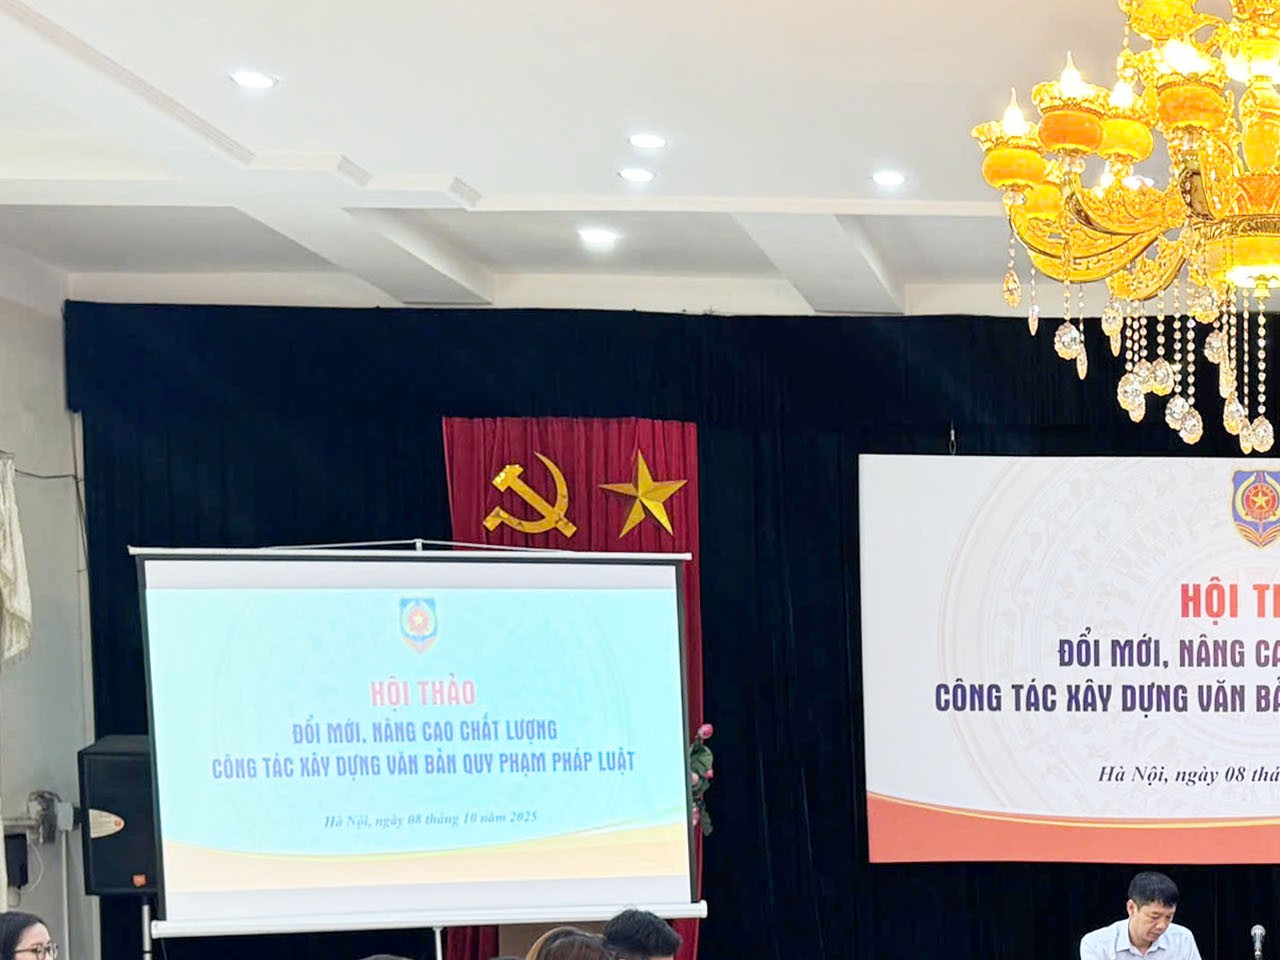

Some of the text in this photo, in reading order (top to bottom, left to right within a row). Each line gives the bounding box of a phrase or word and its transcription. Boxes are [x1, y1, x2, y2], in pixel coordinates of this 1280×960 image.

[1181, 576, 1239, 626] HỘI
[1058, 627, 1100, 668] ĐỔI
[1111, 633, 1169, 669] MỚI,
[1179, 634, 1245, 668] NÂNG
[371, 673, 476, 712] HỘI THẢO
[935, 677, 1002, 712] CÔNG
[1011, 677, 1057, 713] TÁC
[1066, 678, 1113, 713] XÂY
[1121, 682, 1188, 719] DỰNG
[1197, 679, 1246, 713] VĂN
[372, 718, 416, 742] NÂNG
[422, 721, 454, 742] CAO
[460, 712, 500, 741] CHẤT
[506, 718, 558, 745] LƯỢNG
[212, 754, 257, 779] CÔNG
[262, 752, 294, 778] TÁC
[336, 754, 381, 781] DỰNG
[463, 752, 493, 774] QUY
[500, 751, 546, 777] PHẠM
[552, 747, 593, 772] PHÁP
[599, 747, 635, 775] LUẬT
[1098, 765, 1126, 782] Hà
[1131, 765, 1168, 787] Nội,
[1175, 765, 1219, 787] ngày
[1224, 766, 1246, 782] 08
[509, 811, 538, 823] 2025
